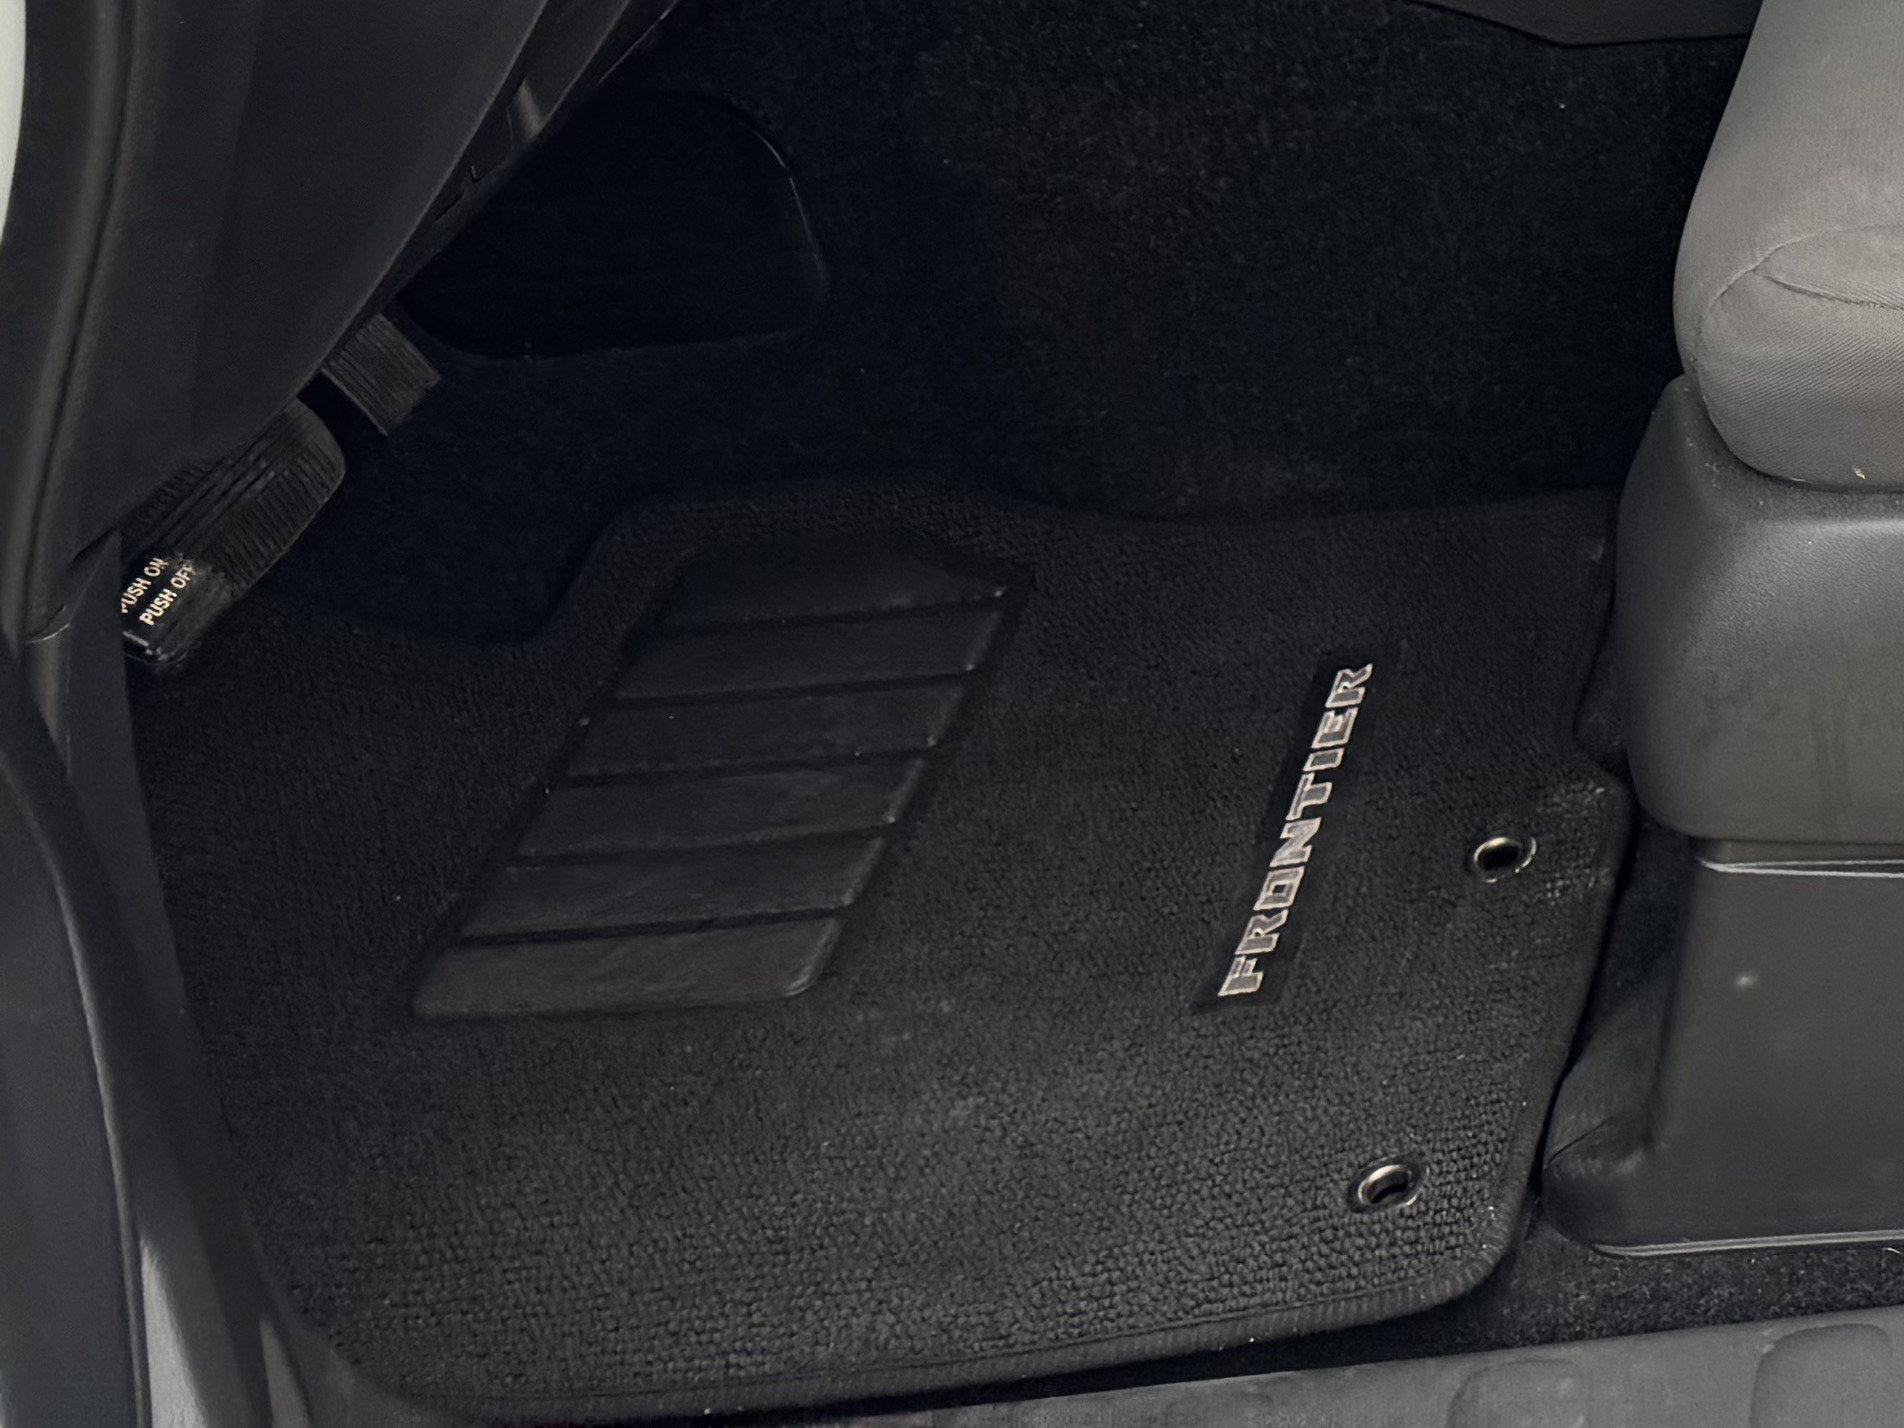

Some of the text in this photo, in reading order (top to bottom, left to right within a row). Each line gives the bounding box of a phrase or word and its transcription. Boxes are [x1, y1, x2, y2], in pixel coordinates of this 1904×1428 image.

[144, 557, 169, 578] ON
[139, 588, 178, 626] PUSH
[1217, 663, 1373, 996] FRONTIER
